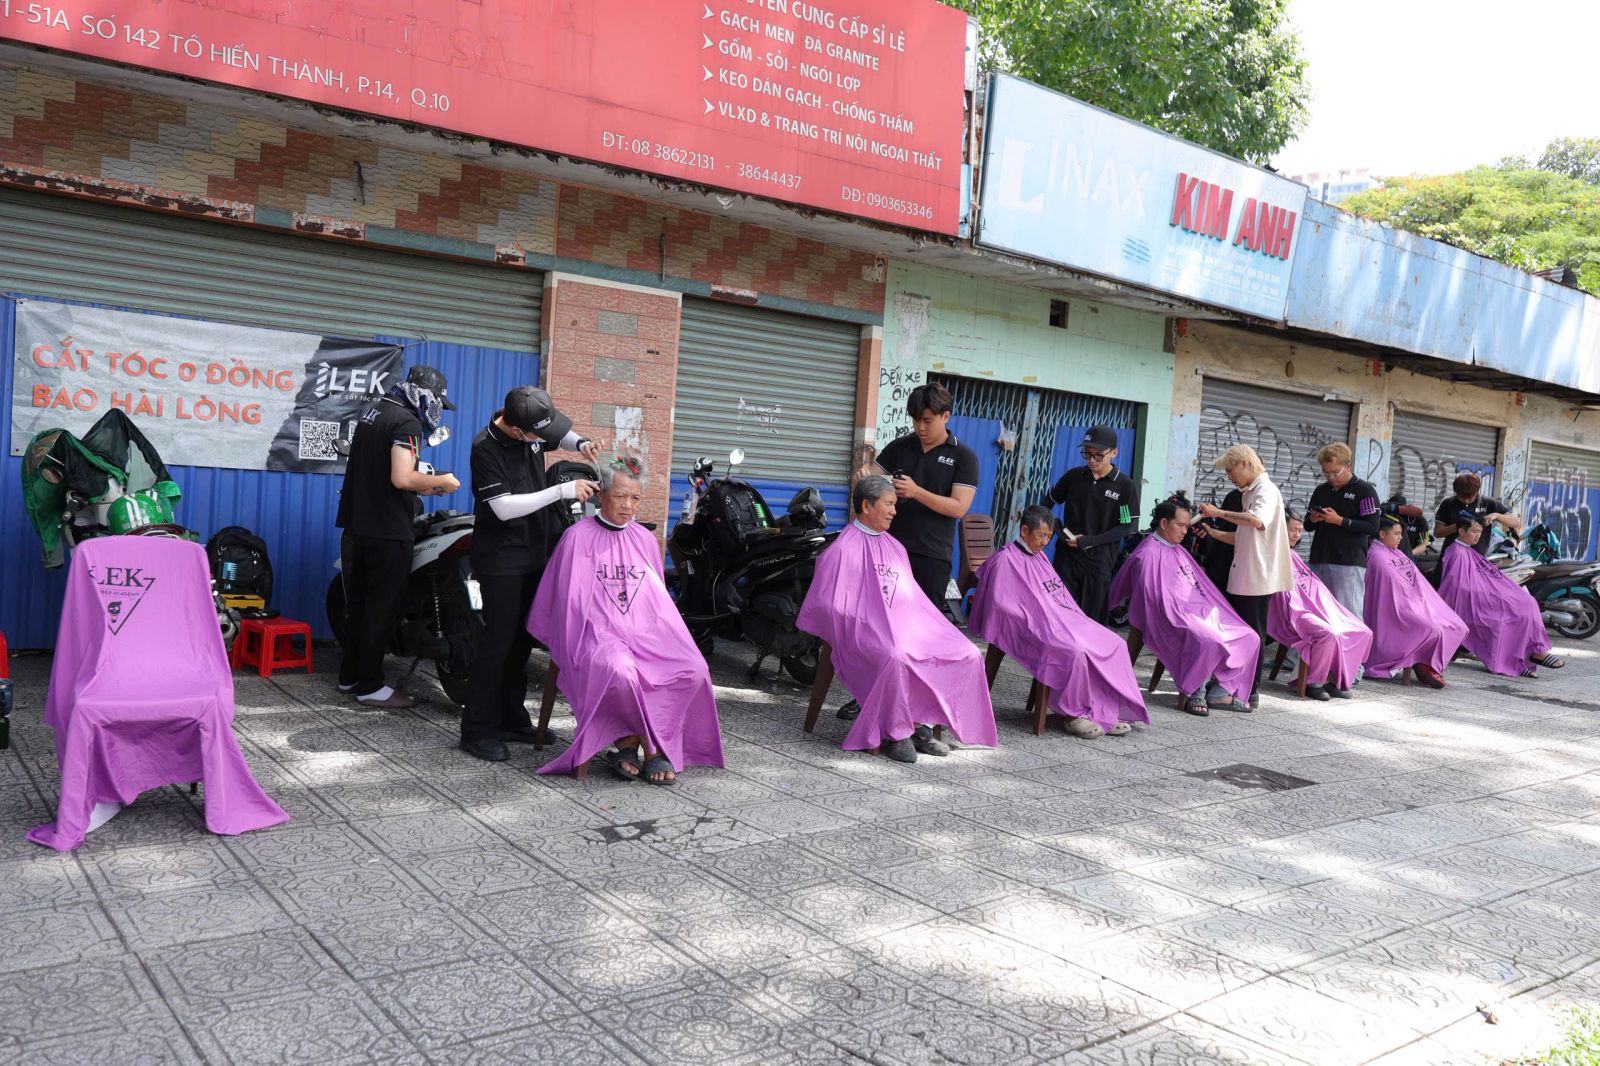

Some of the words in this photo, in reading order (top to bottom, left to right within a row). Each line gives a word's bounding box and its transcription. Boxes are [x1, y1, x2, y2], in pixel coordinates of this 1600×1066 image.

[718, 37, 753, 61] GỐM
[720, 10, 760, 34] GẠCH
[765, 23, 795, 45] MEN
[825, 42, 879, 71] GRANITE
[792, 1, 834, 29] CUNG
[839, 15, 869, 39] CẤP
[872, 24, 886, 46] SỈ
[81, 14, 117, 39] SỐ
[123, 24, 161, 50] 142
[168, 34, 203, 58] TÔ
[210, 43, 259, 71] HIẾN
[267, 58, 351, 93] THÀNH,
[358, 76, 400, 103] P.14,
[411, 88, 450, 112] Q.10
[719, 67, 748, 89] KEO
[752, 76, 782, 98] DÁN
[785, 87, 821, 109] GẠCH
[832, 100, 876, 124] CHỐNG
[879, 112, 913, 135] THẤM
[718, 100, 757, 123] VLXD
[760, 112, 770, 127] &
[774, 115, 819, 139] TRANG
[822, 127, 842, 145] TRÍ
[845, 132, 867, 154] NỘI
[871, 140, 909, 165] NGOẠI
[912, 151, 942, 171] THẤT
[653, 143, 714, 170] 38622131
[737, 162, 801, 189] 38644437
[1170, 172, 1234, 242] KIM
[1232, 197, 1297, 261] ANH
[33, 336, 94, 372] CẮT
[106, 351, 168, 379] TÓC
[205, 358, 294, 391] ĐỒNG
[32, 384, 98, 411] BAO
[111, 388, 163, 418] HÀI
[176, 394, 262, 424] LÒNG
[603, 564, 639, 580] LEK
